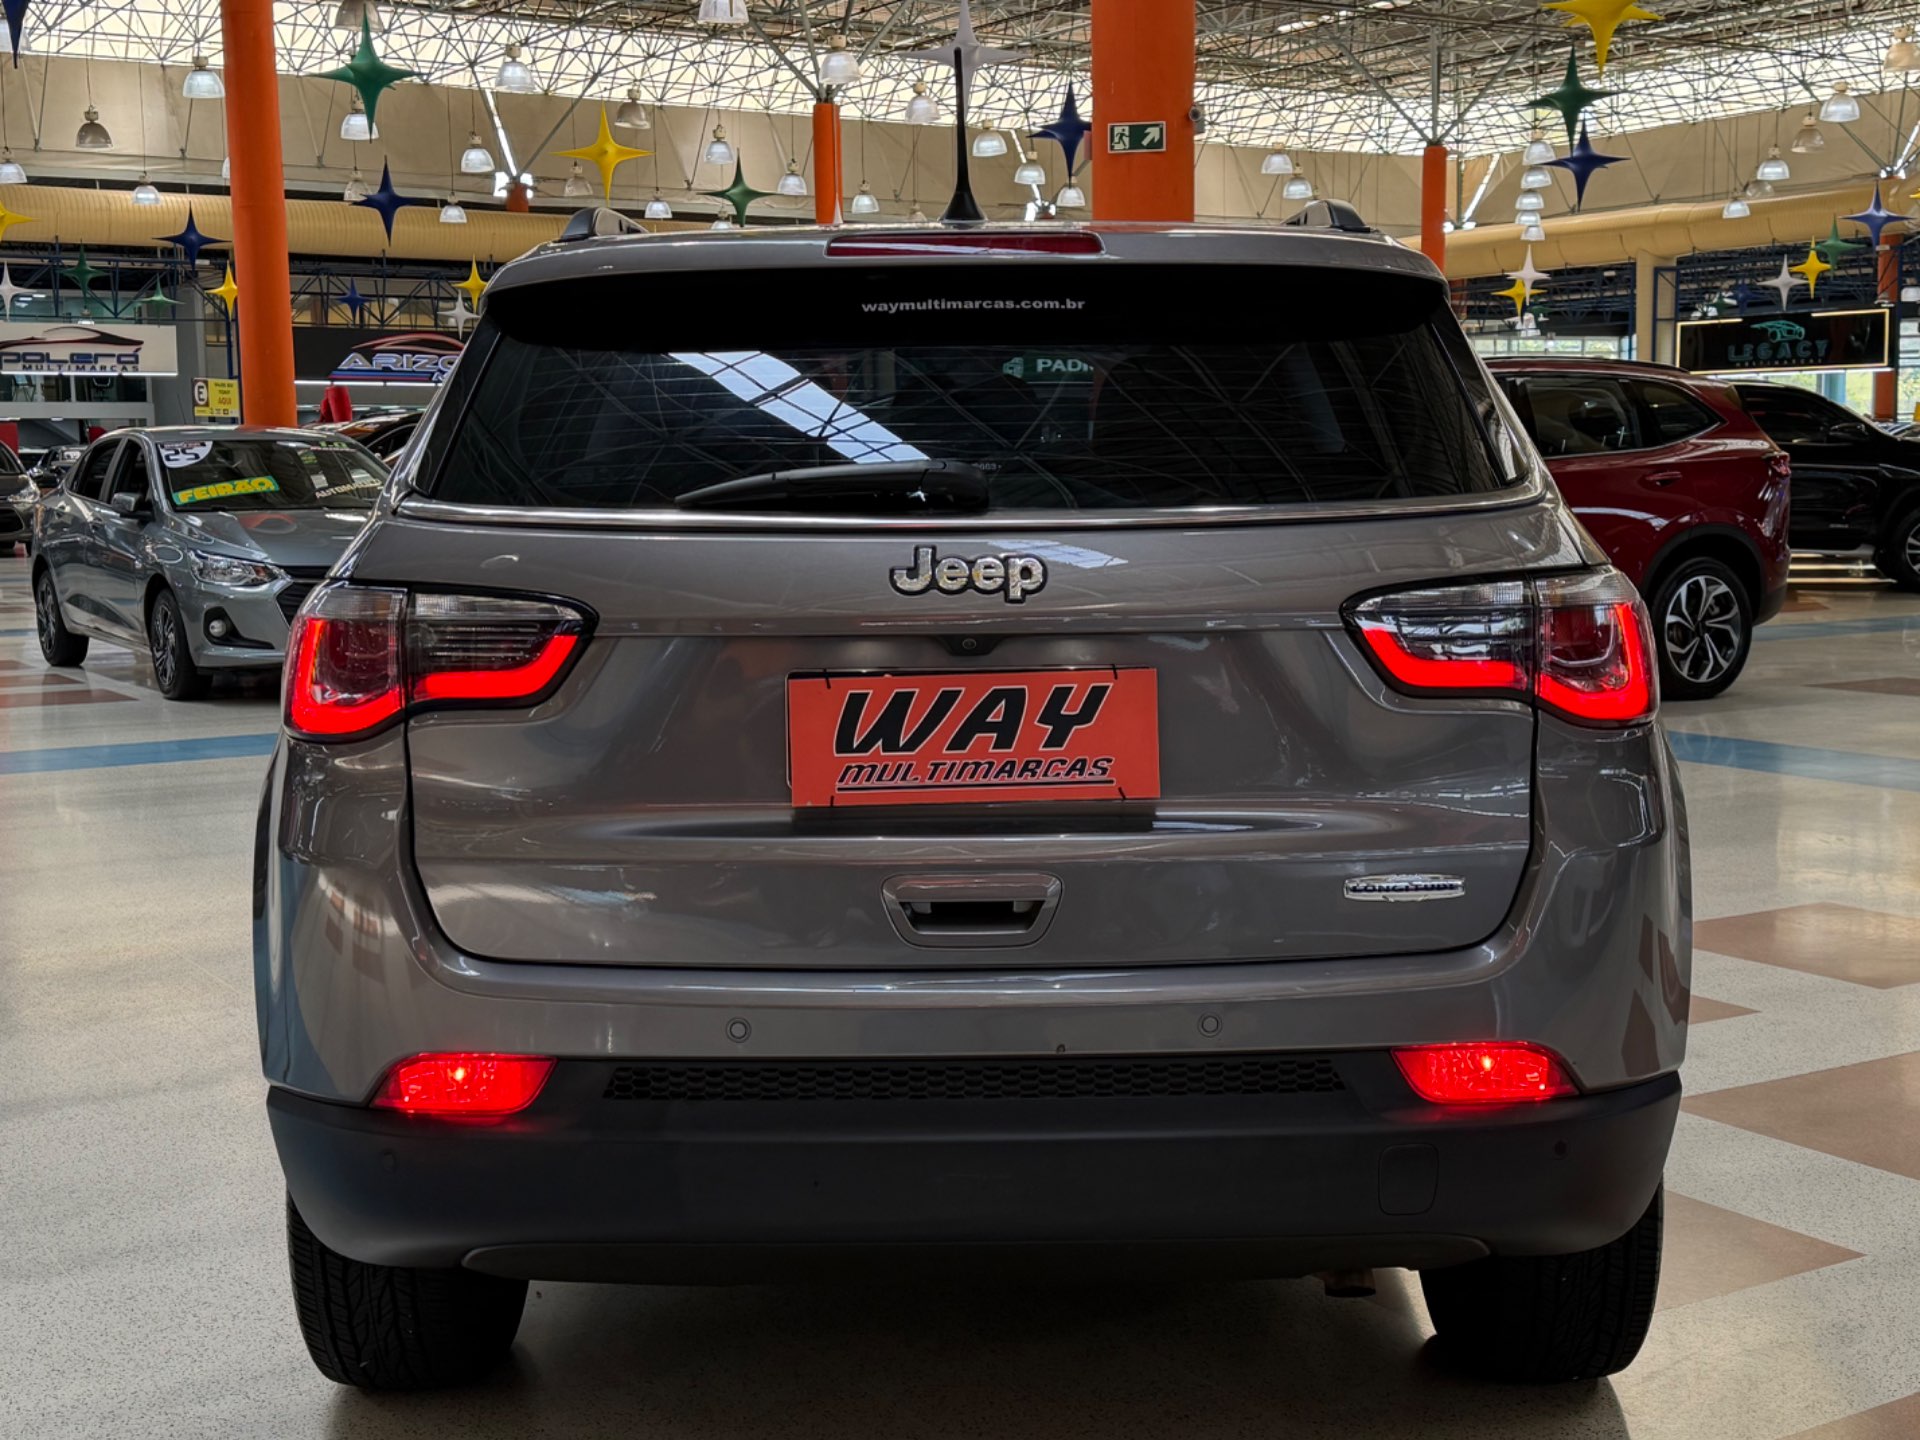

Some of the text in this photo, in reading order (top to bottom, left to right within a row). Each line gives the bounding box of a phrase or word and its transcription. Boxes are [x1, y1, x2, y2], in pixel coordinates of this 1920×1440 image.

[861, 298, 1086, 313] waymultimarcas.com.br
[1727, 340, 1829, 362] LEGACY
[22, 364, 140, 372] MULTIMARCAS
[164, 448, 201, 462] 25
[892, 546, 1046, 602] Jeep
[834, 683, 1113, 757] WAY
[837, 756, 1115, 785] MULTIMARCAS
